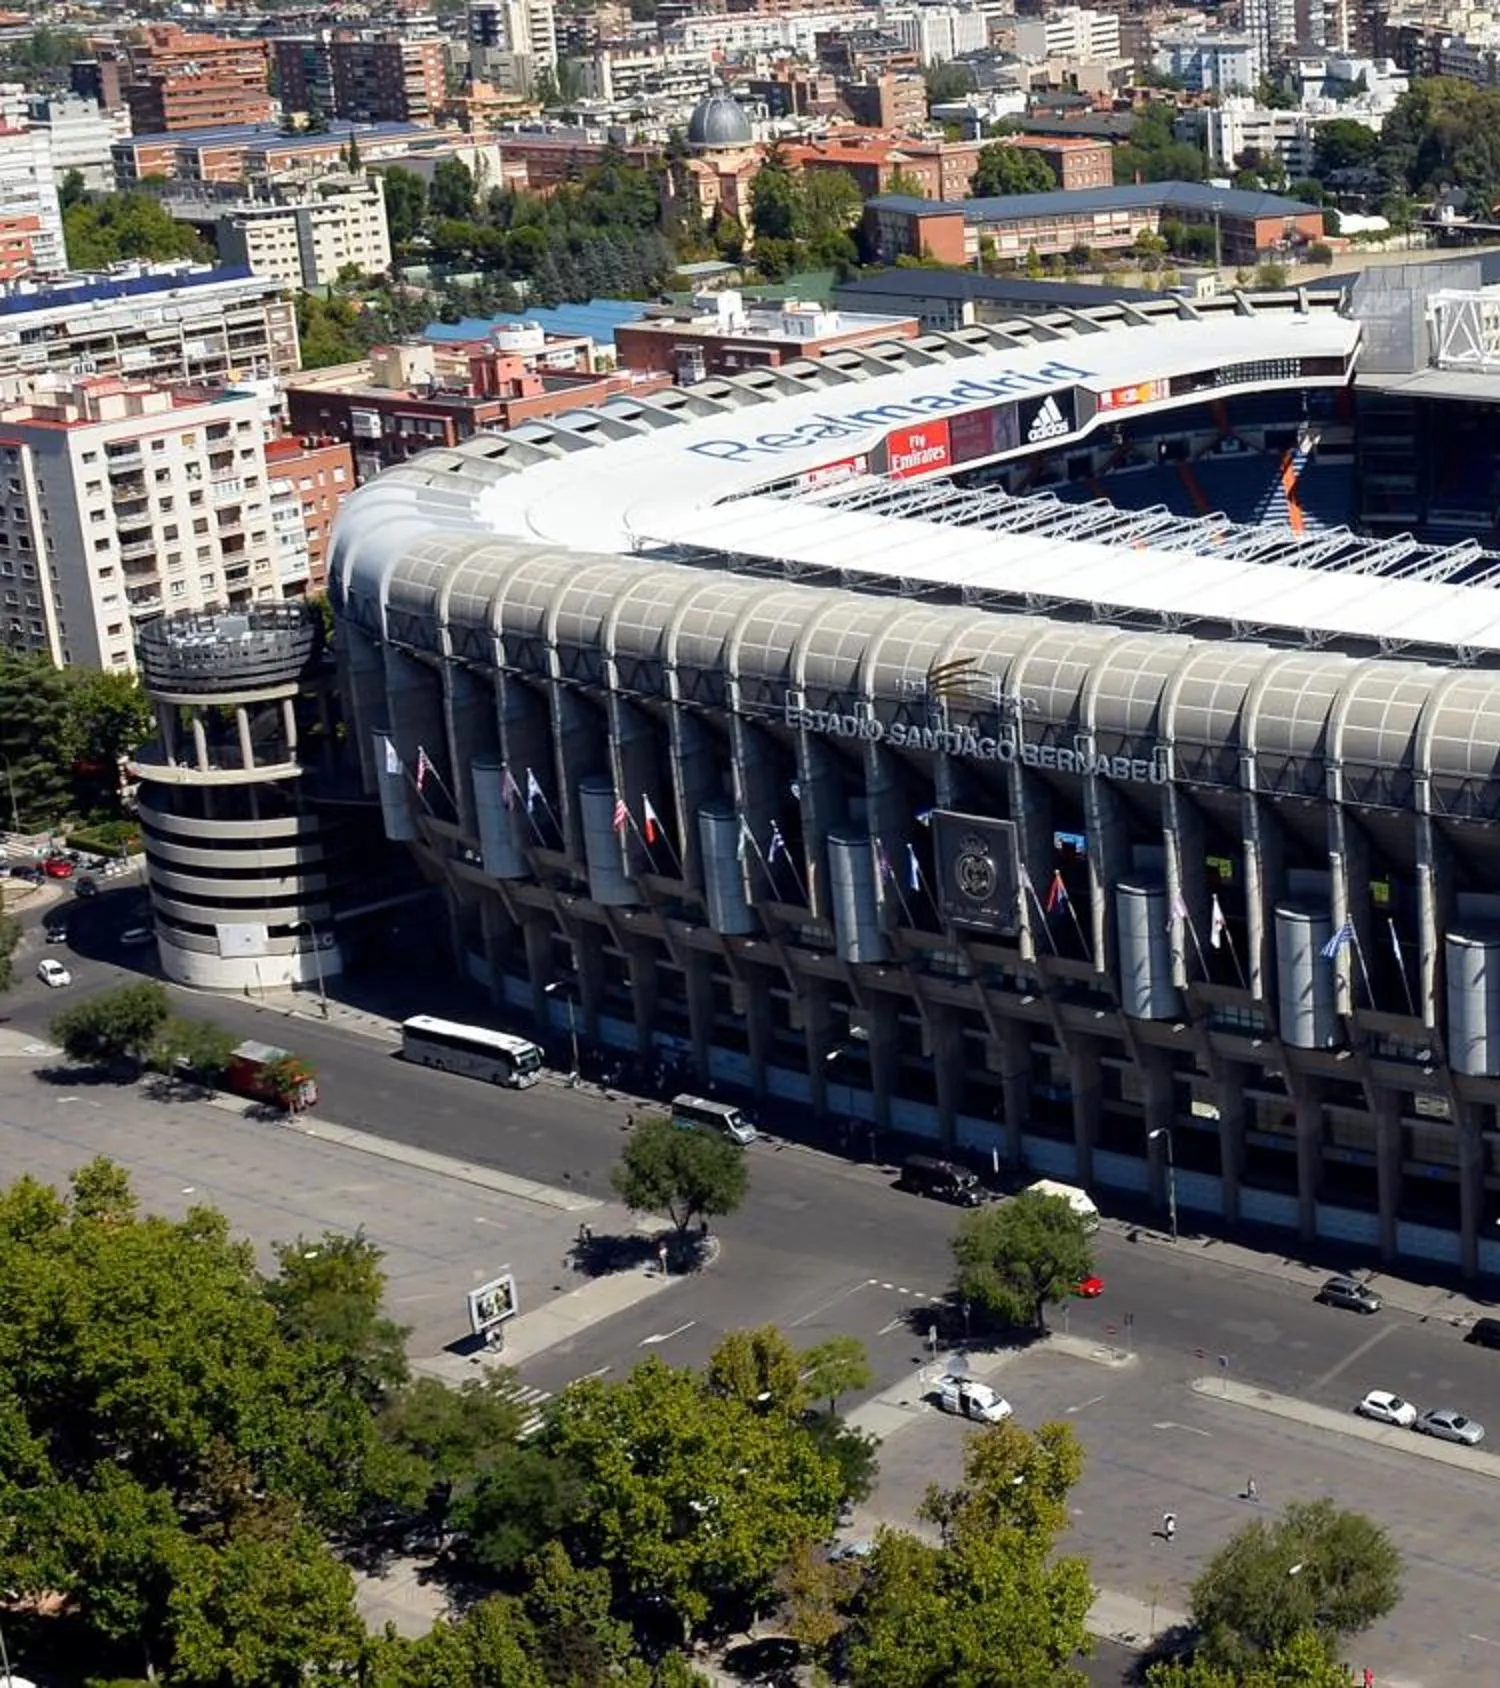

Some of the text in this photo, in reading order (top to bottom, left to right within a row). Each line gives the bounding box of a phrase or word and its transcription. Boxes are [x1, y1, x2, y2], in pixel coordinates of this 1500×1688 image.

[908, 433, 927, 450] Fly
[1027, 421, 1070, 443] adidas
[891, 445, 946, 471] Emirates
[784, 705, 884, 742] ESTADIO
[889, 722, 1017, 763] SANTIAGO
